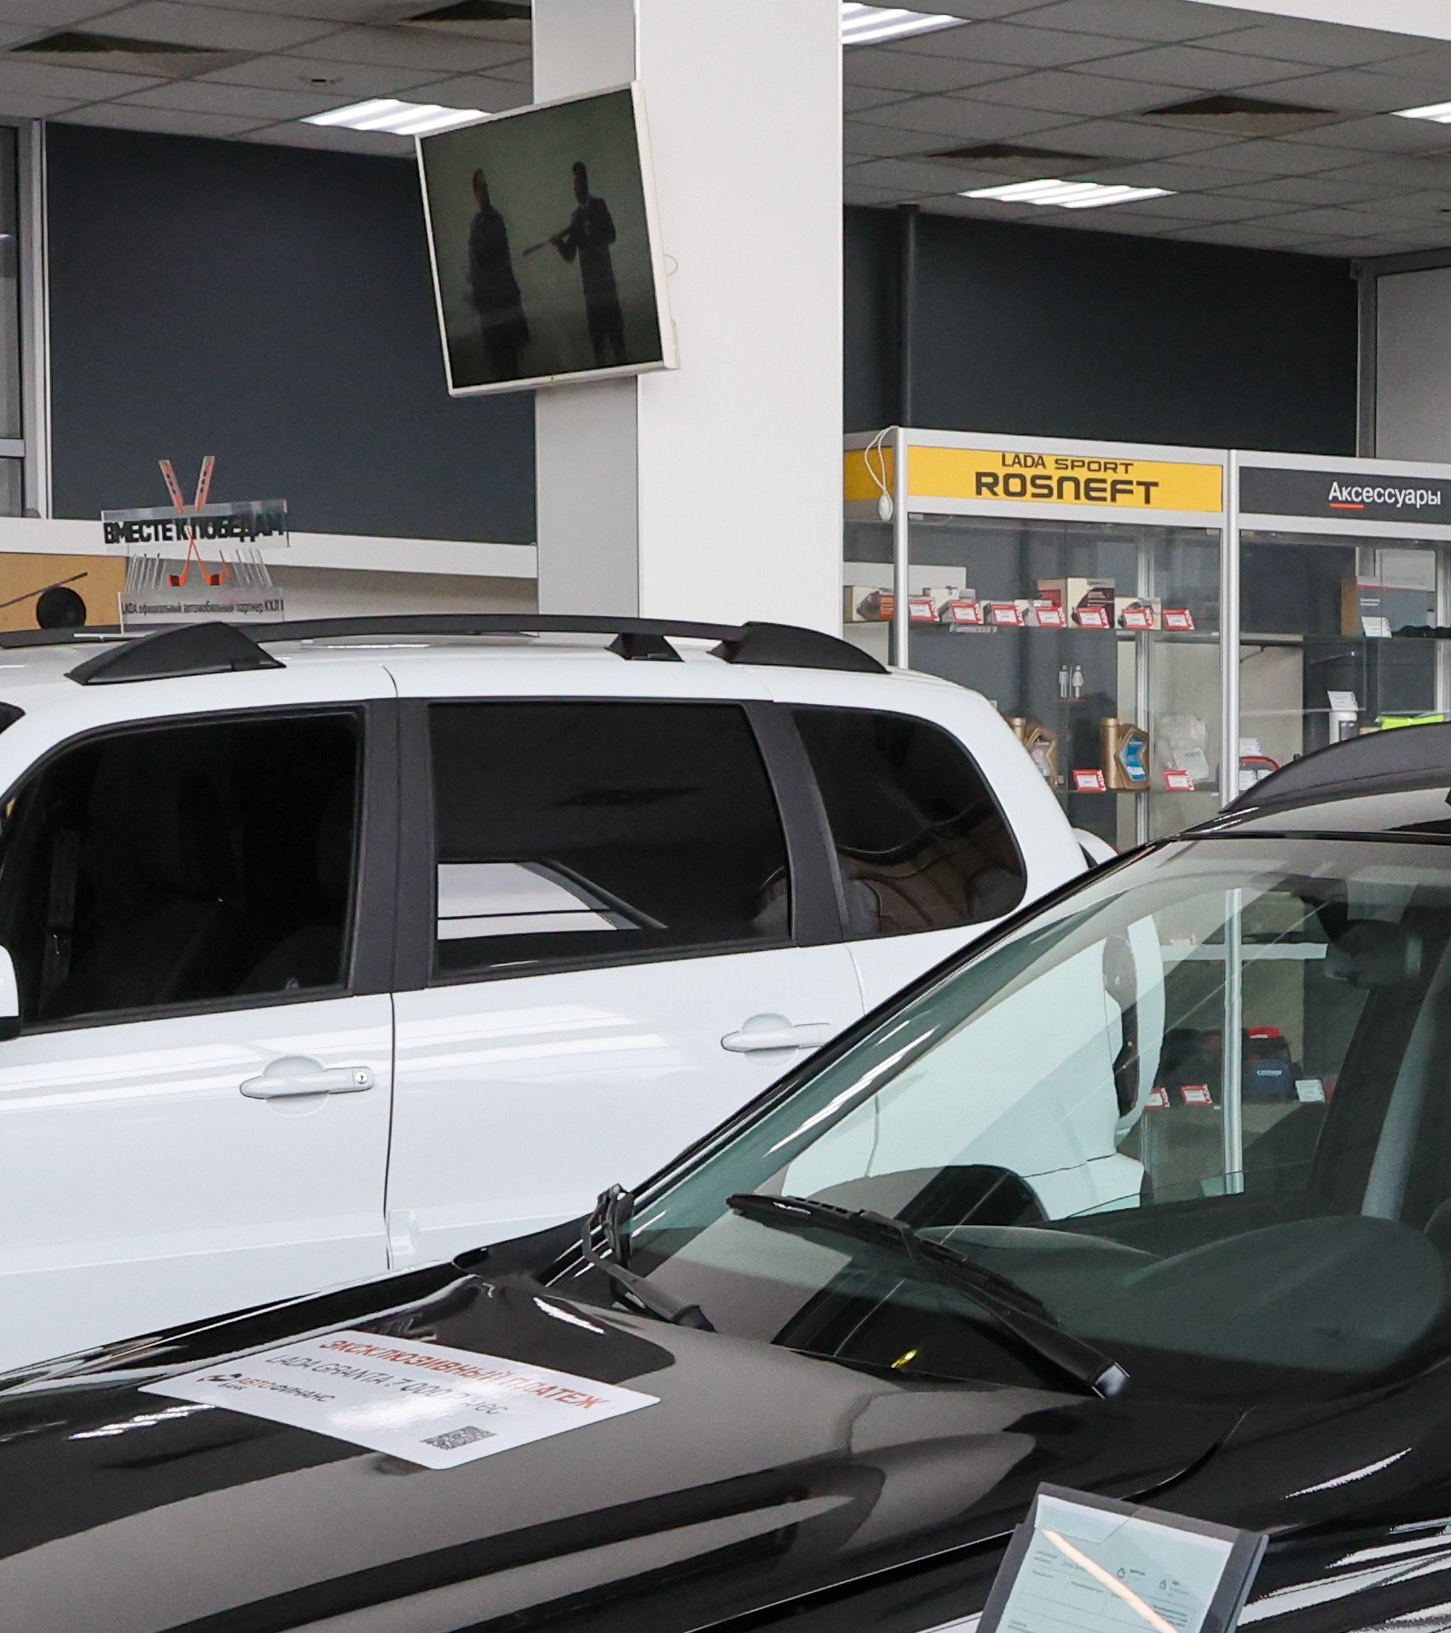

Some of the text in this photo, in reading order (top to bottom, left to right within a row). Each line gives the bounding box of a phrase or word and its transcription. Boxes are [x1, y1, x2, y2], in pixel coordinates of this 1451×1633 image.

[1001, 453, 1134, 474] LADA SPORT
[975, 471, 1160, 505] ROSNEFT
[1328, 481, 1442, 508] Аксессуары
[104, 519, 174, 544] ВМЕСТЕ
[265, 1354, 313, 1370] LADA
[312, 1362, 391, 1386] GRANTA
[319, 1339, 510, 1386] ЭКСКЛЮЗИВНЫЙ
